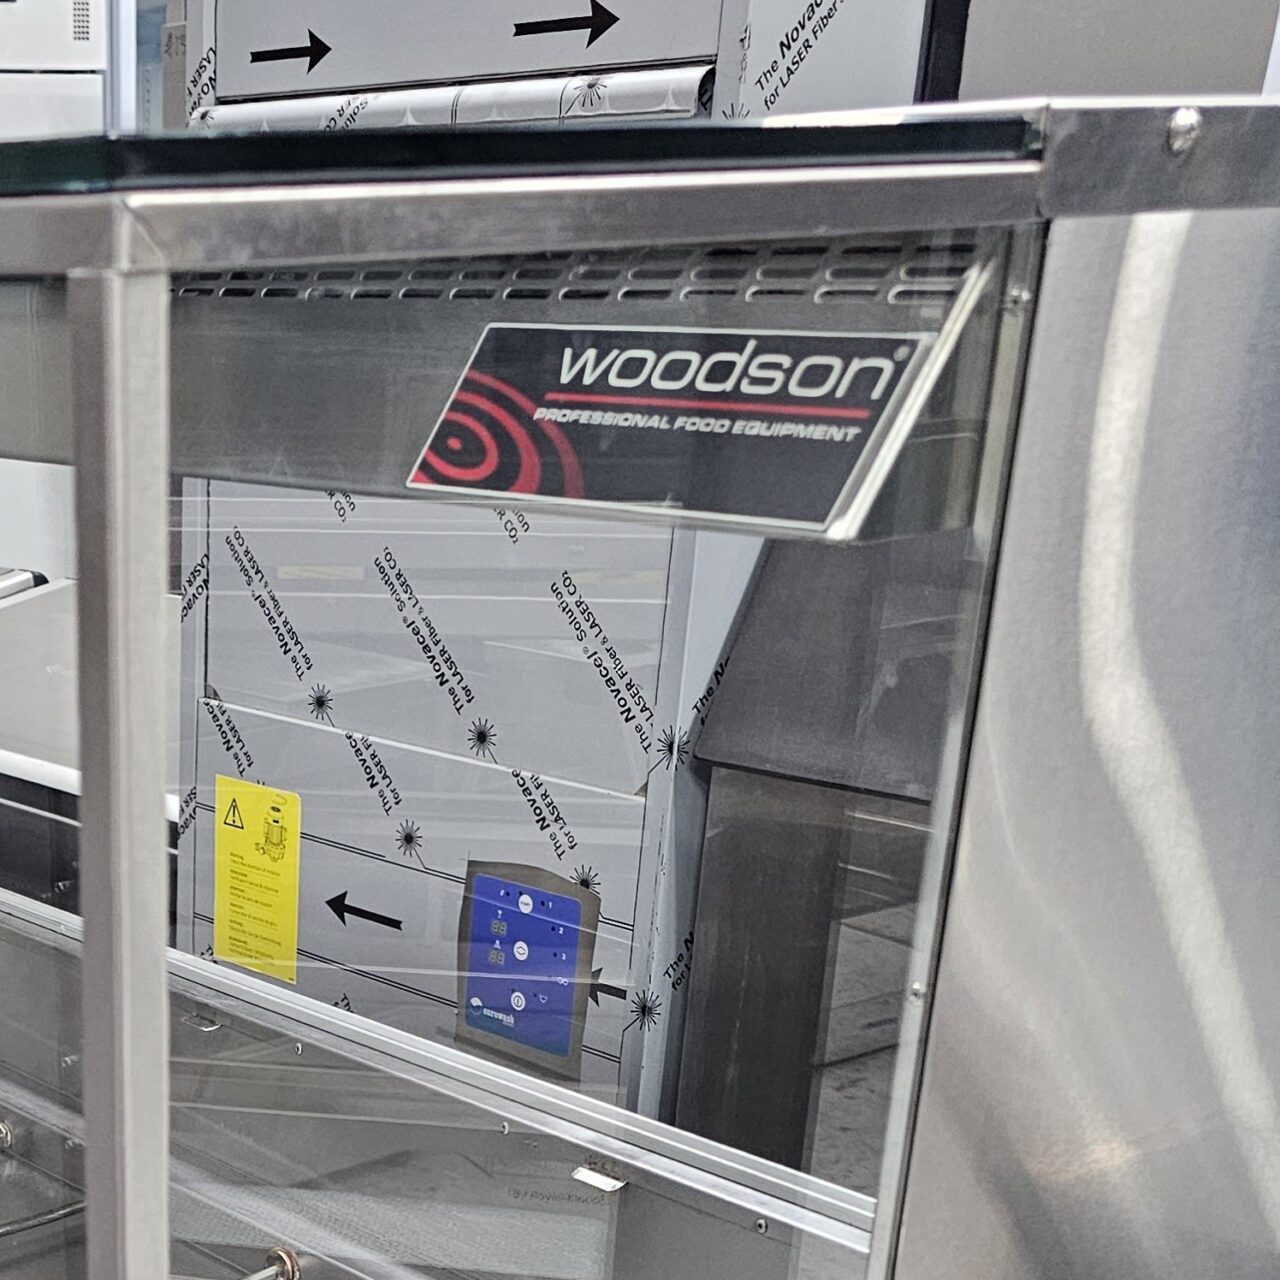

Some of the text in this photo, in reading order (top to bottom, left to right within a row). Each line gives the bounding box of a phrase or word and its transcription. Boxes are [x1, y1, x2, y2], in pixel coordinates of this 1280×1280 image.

[754, 0, 824, 91] The Novac
[763, 1, 838, 112] for LASER Fiber
[532, 407, 862, 442] PROFESSIONAL FOOD EQUIPMENT
[225, 535, 254, 587] Solution
[243, 545, 265, 583] LASER
[374, 557, 406, 612] Solution
[395, 568, 419, 609] LASER
[266, 589, 285, 618] Fiber
[550, 581, 587, 642] Solution
[575, 594, 603, 638] LASER
[282, 616, 305, 653] LASER
[421, 615, 442, 646] Fiber
[290, 654, 305, 682] The
[301, 653, 314, 671] for
[439, 644, 463, 685] LASER
[604, 646, 629, 680] Fiber
[448, 686, 465, 715] The
[462, 683, 475, 704] for
[624, 678, 654, 723] LASER
[691, 686, 714, 714] The
[225, 715, 245, 751] LASER
[634, 723, 653, 754] The
[232, 752, 246, 778] The
[370, 749, 402, 806] for LASER
[378, 789, 392, 817] The
[540, 788, 578, 850] for LASER
[549, 831, 566, 861] The
